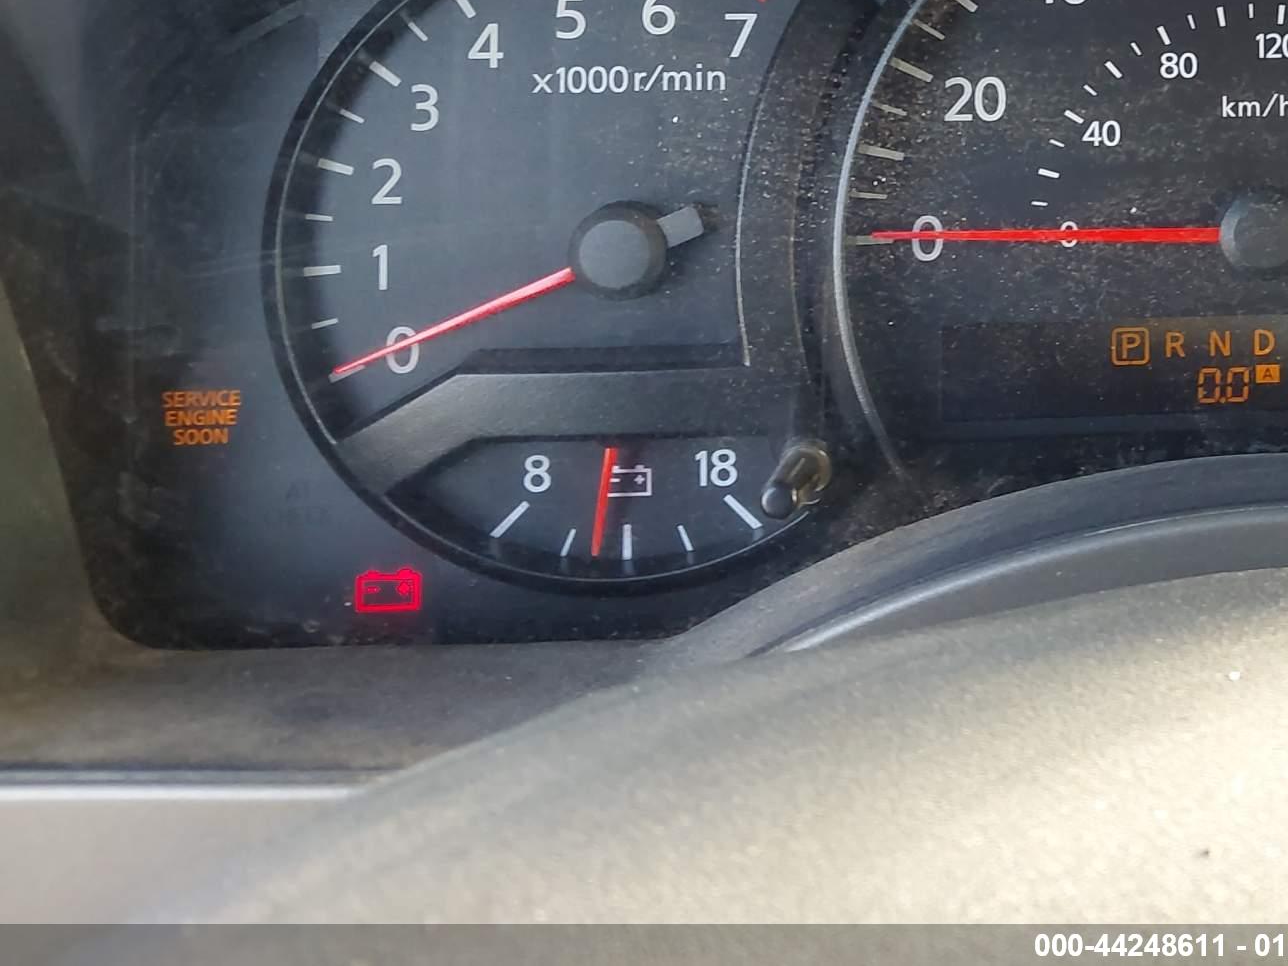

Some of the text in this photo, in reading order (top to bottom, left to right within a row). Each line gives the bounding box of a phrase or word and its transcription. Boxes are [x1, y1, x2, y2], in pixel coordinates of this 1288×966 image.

[467, 24, 504, 69] 4
[725, 13, 760, 58] 7
[1160, 52, 1198, 79] 80
[410, 85, 439, 131] 3
[944, 76, 1006, 123] 20
[1082, 120, 1121, 147] 40
[371, 159, 402, 205] 2
[912, 215, 943, 262] 0
[373, 243, 389, 290] 1
[385, 326, 420, 374] 0
[1121, 333, 1141, 359] P
[1165, 331, 1185, 358] R
[1209, 330, 1231, 357] N
[1254, 329, 1276, 356] D
[162, 390, 242, 410] SERVICE
[1197, 367, 1249, 404] 0.0
[165, 409, 238, 428] ENGINE
[173, 428, 229, 446] SOON
[523, 454, 551, 494] 8
[696, 449, 738, 488] 18
